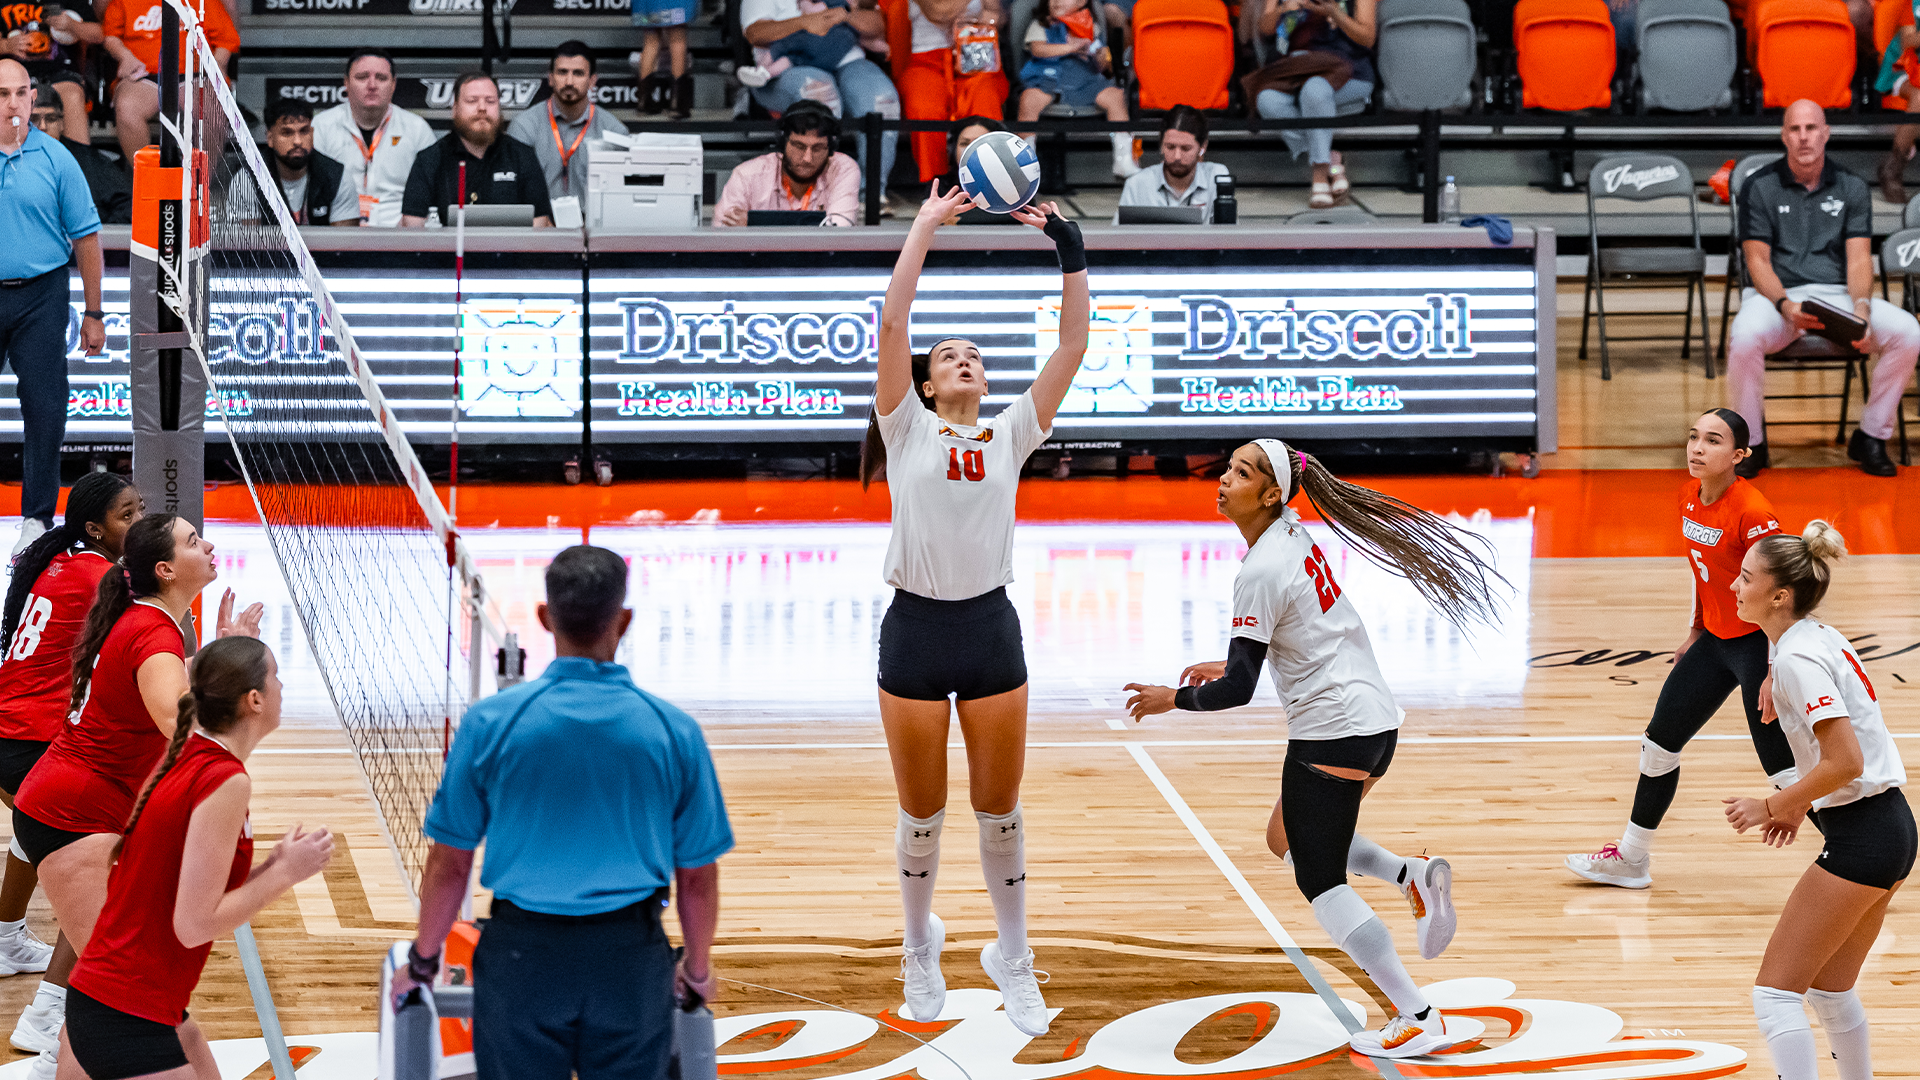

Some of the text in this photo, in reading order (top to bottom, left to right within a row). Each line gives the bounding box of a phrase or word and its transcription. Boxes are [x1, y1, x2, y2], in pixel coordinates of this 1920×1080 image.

[279, 85, 350, 103] SECTIO
[163, 204, 176, 245] sports
[1179, 293, 1477, 360] Driscoll
[618, 380, 844, 416] Health Plan
[1180, 375, 1403, 412] Health Plan
[92, 444, 133, 453] INTERAC
[1064, 441, 1122, 450] INTERACTIVE
[946, 446, 986, 482] 10
[1690, 548, 1710, 584] 5
[1641, 1028, 1686, 1037] TM
